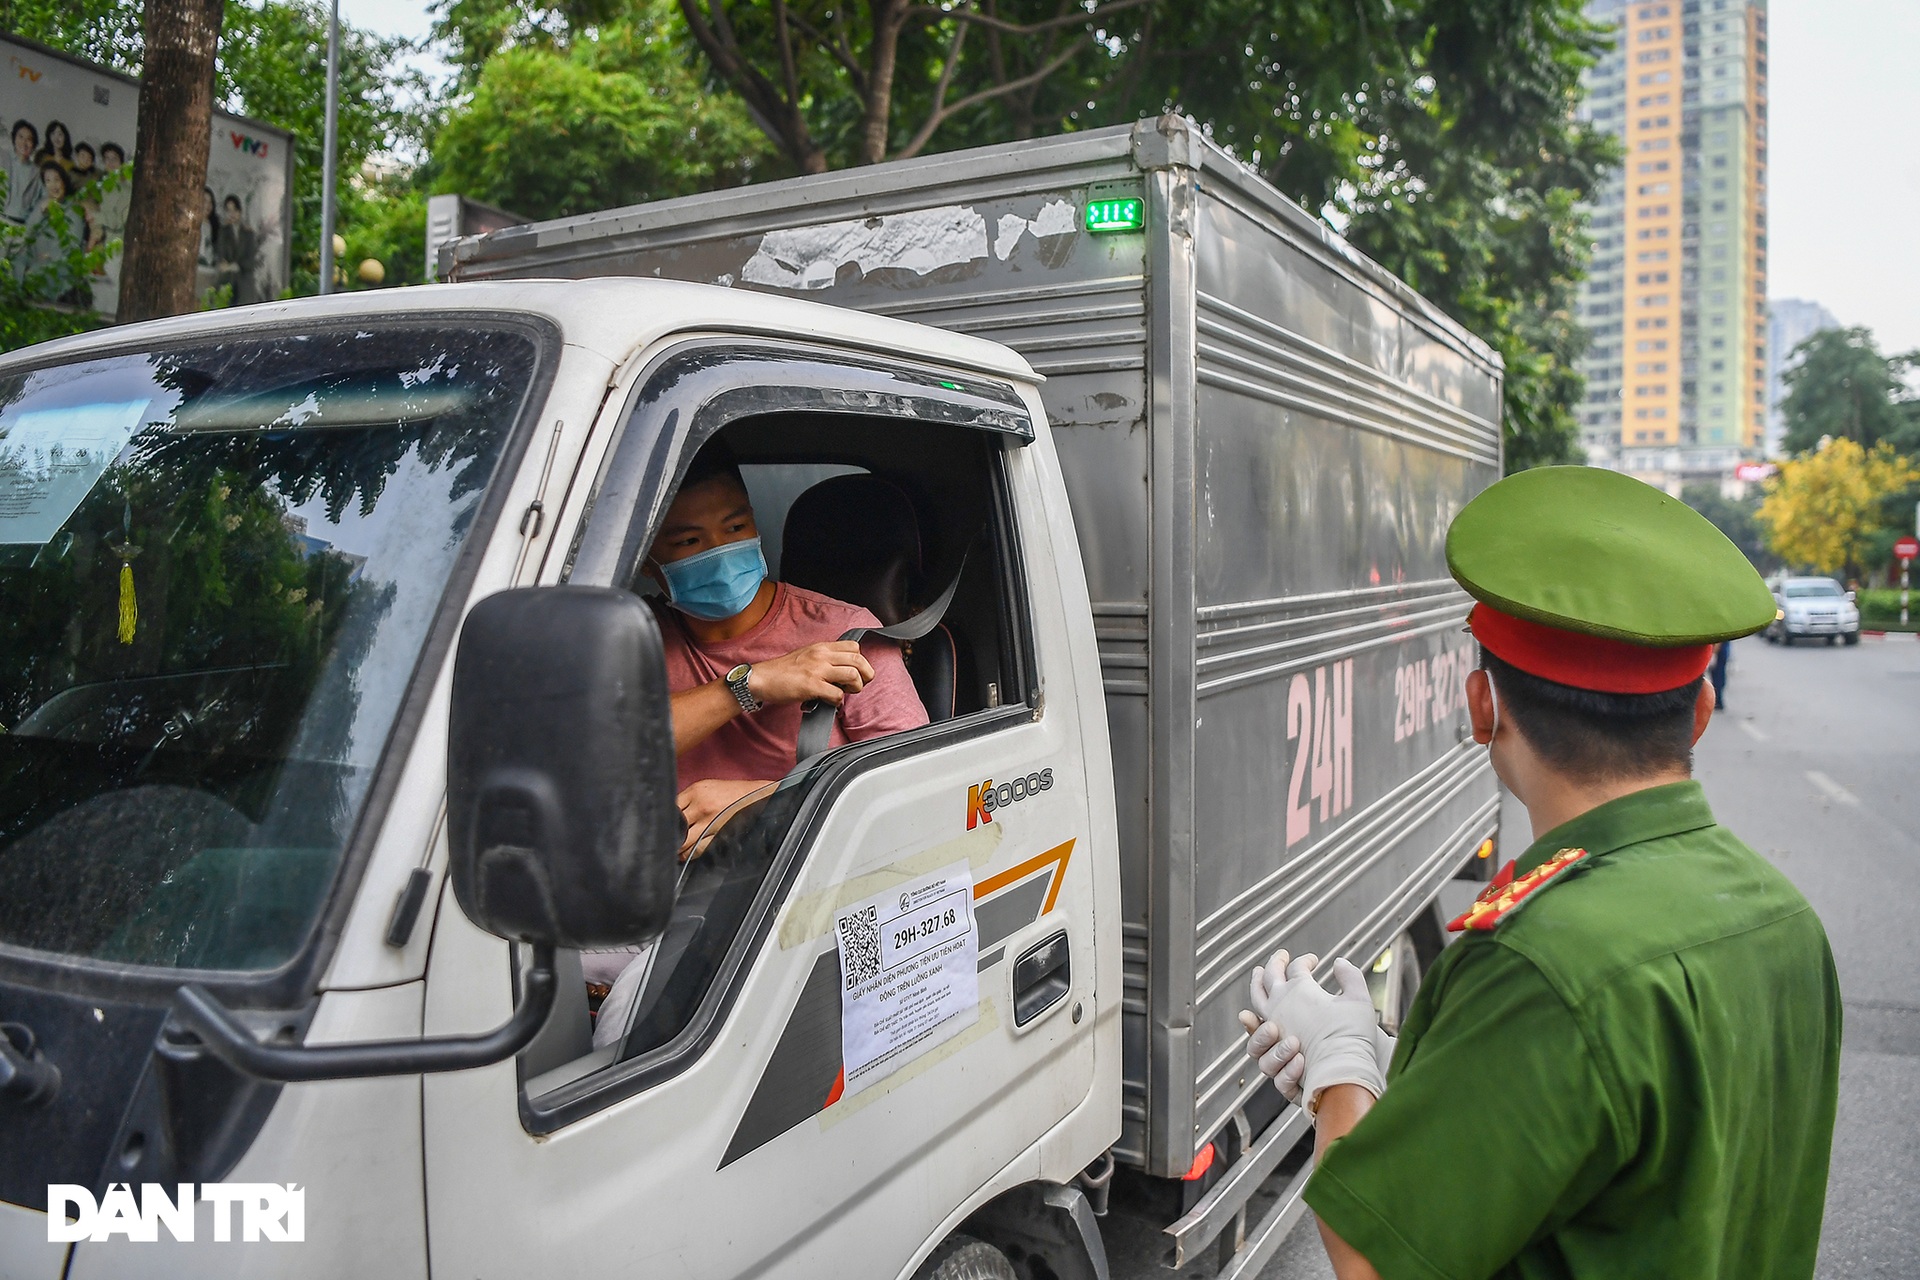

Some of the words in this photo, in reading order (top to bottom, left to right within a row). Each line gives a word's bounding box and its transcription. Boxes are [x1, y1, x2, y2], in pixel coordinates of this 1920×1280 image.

[230, 130, 269, 158] VTV3
[1286, 657, 1353, 848] 24H
[966, 768, 1054, 831] K3000S
[894, 908, 955, 949] 29H-327.68
[852, 986, 865, 1001] GIẤY
[866, 977, 882, 994] NHẬN
[883, 970, 896, 984] DIỆN
[896, 959, 918, 978] PHƯƠNG
[919, 953, 931, 967] TIỆN
[932, 950, 939, 961] ƯU
[939, 944, 951, 957] TIÊN
[952, 938, 965, 950] HOẠT
[879, 986, 896, 1003] ĐỘNG
[896, 979, 910, 994] TRÊN
[910, 969, 928, 986] LUỒNG
[928, 963, 942, 977] XANH
